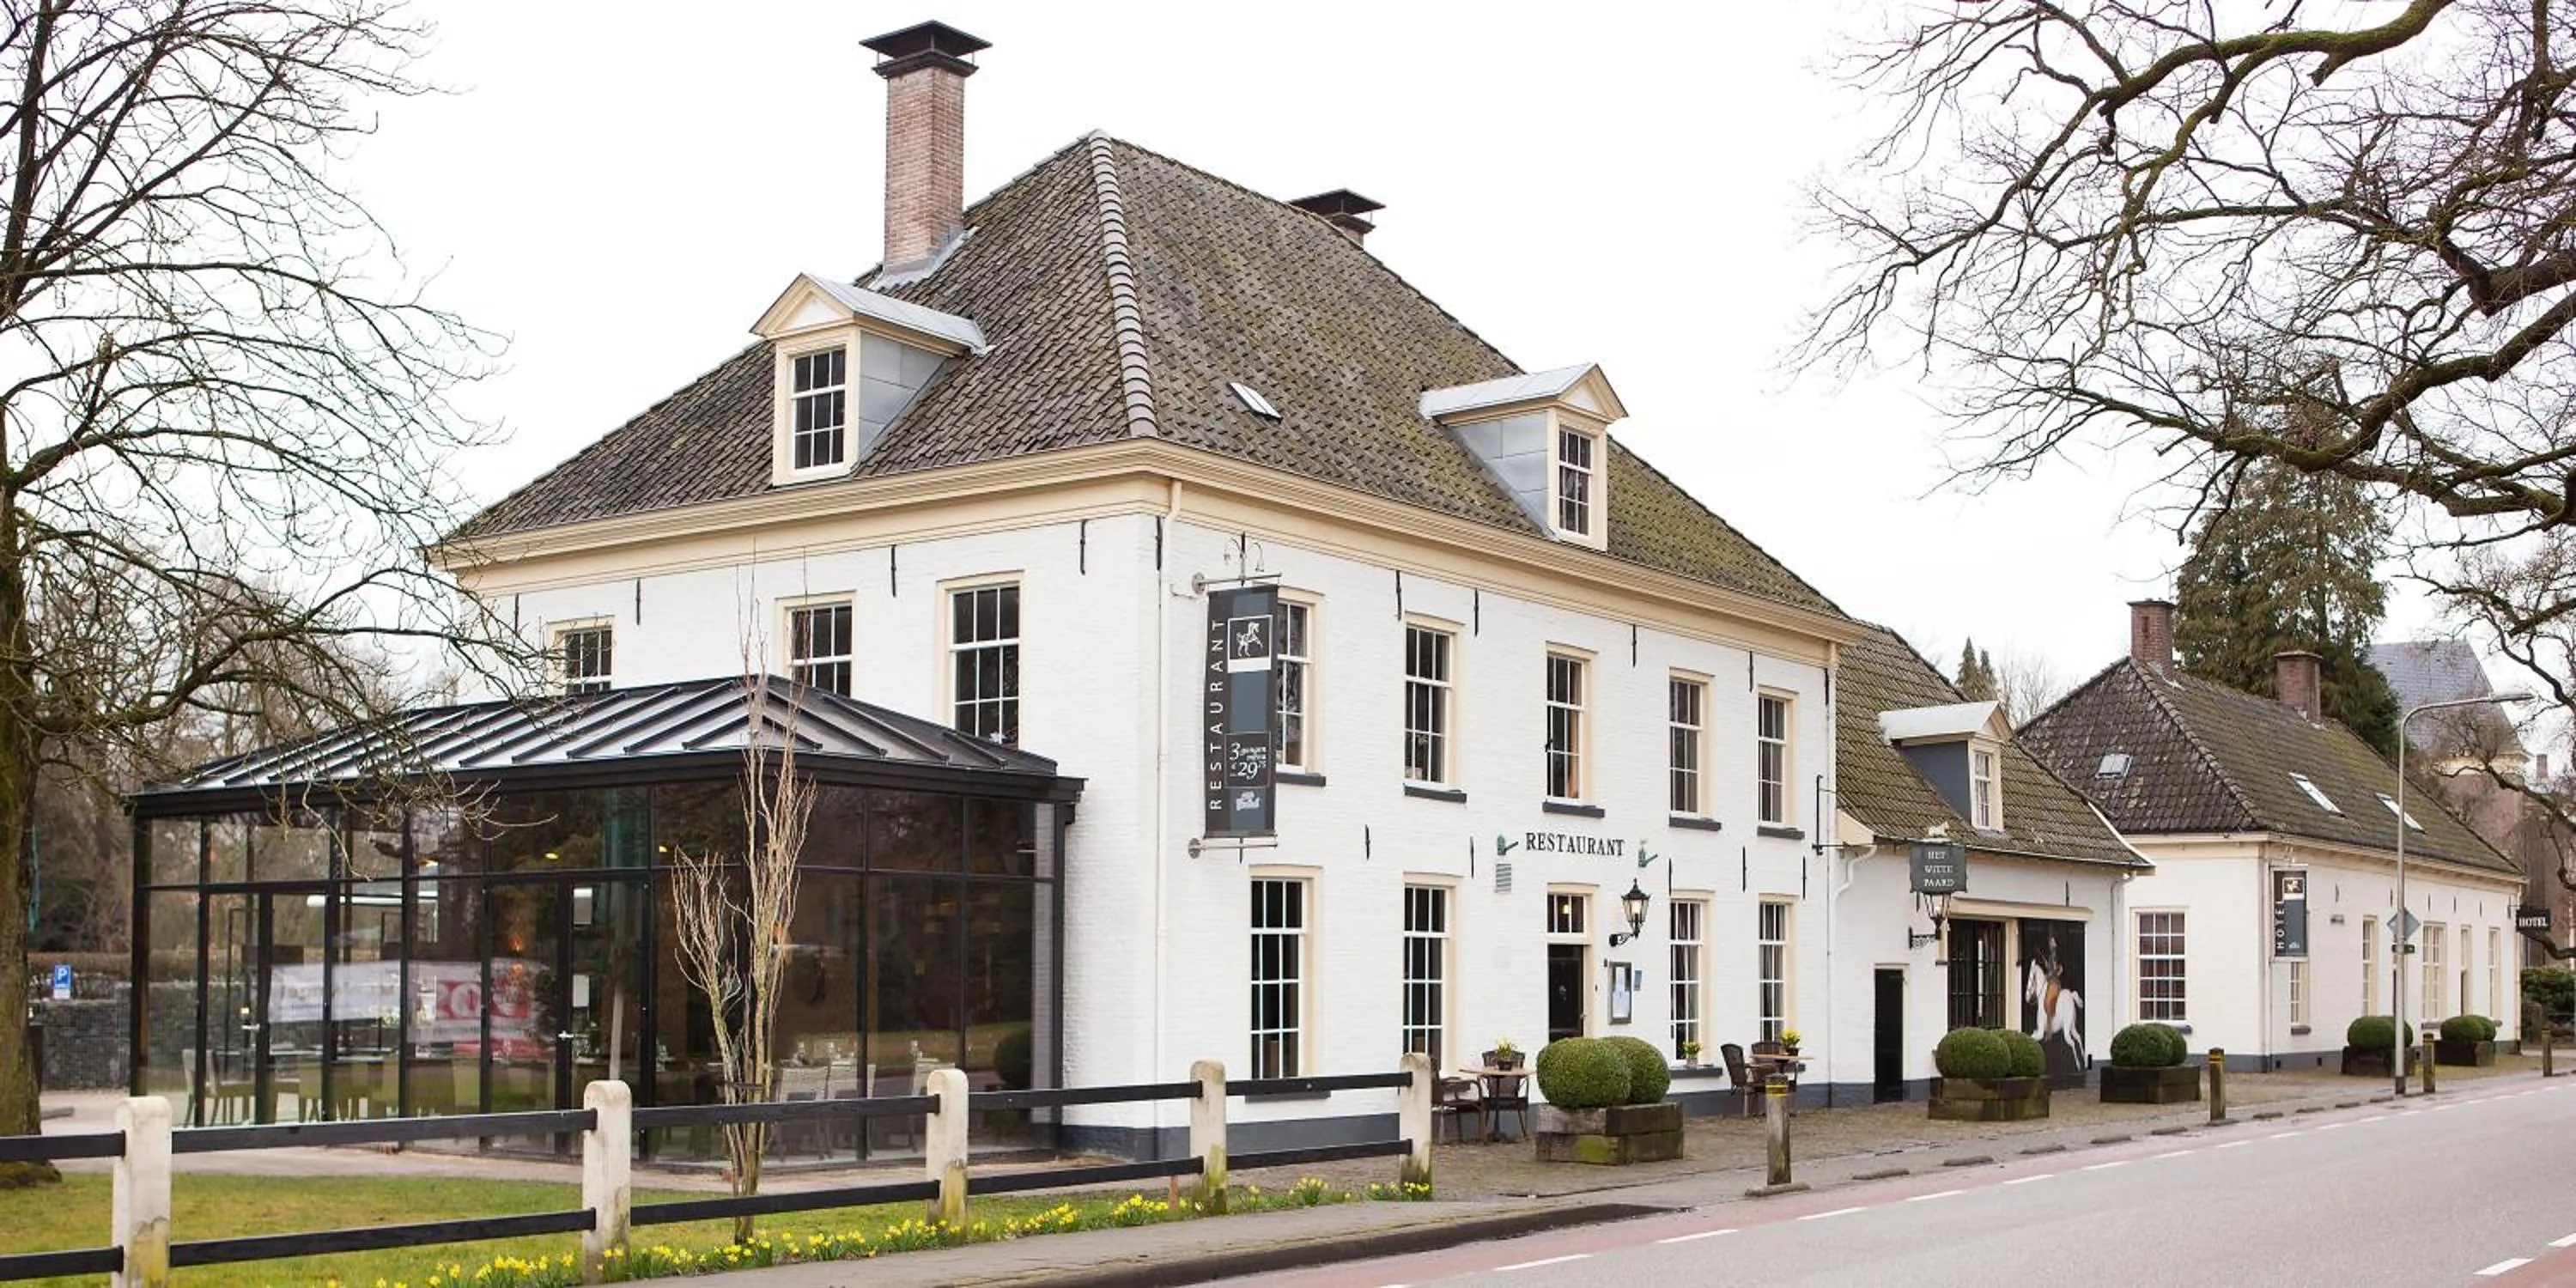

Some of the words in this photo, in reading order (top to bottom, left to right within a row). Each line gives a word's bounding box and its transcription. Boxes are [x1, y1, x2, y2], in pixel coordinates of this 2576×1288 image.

[1210, 620, 1224, 811] RESTAURANT
[1230, 742, 1241, 761] 3
[1526, 832, 1625, 857] RESTAURANT
[1928, 851, 1946, 860] HET
[1924, 865, 1953, 874] WITTE
[1924, 878, 1955, 887] PAARD
[2275, 901, 2285, 950] HOTEL
[2518, 916, 2549, 927] HOTEL
[58, 968, 68, 981] P
